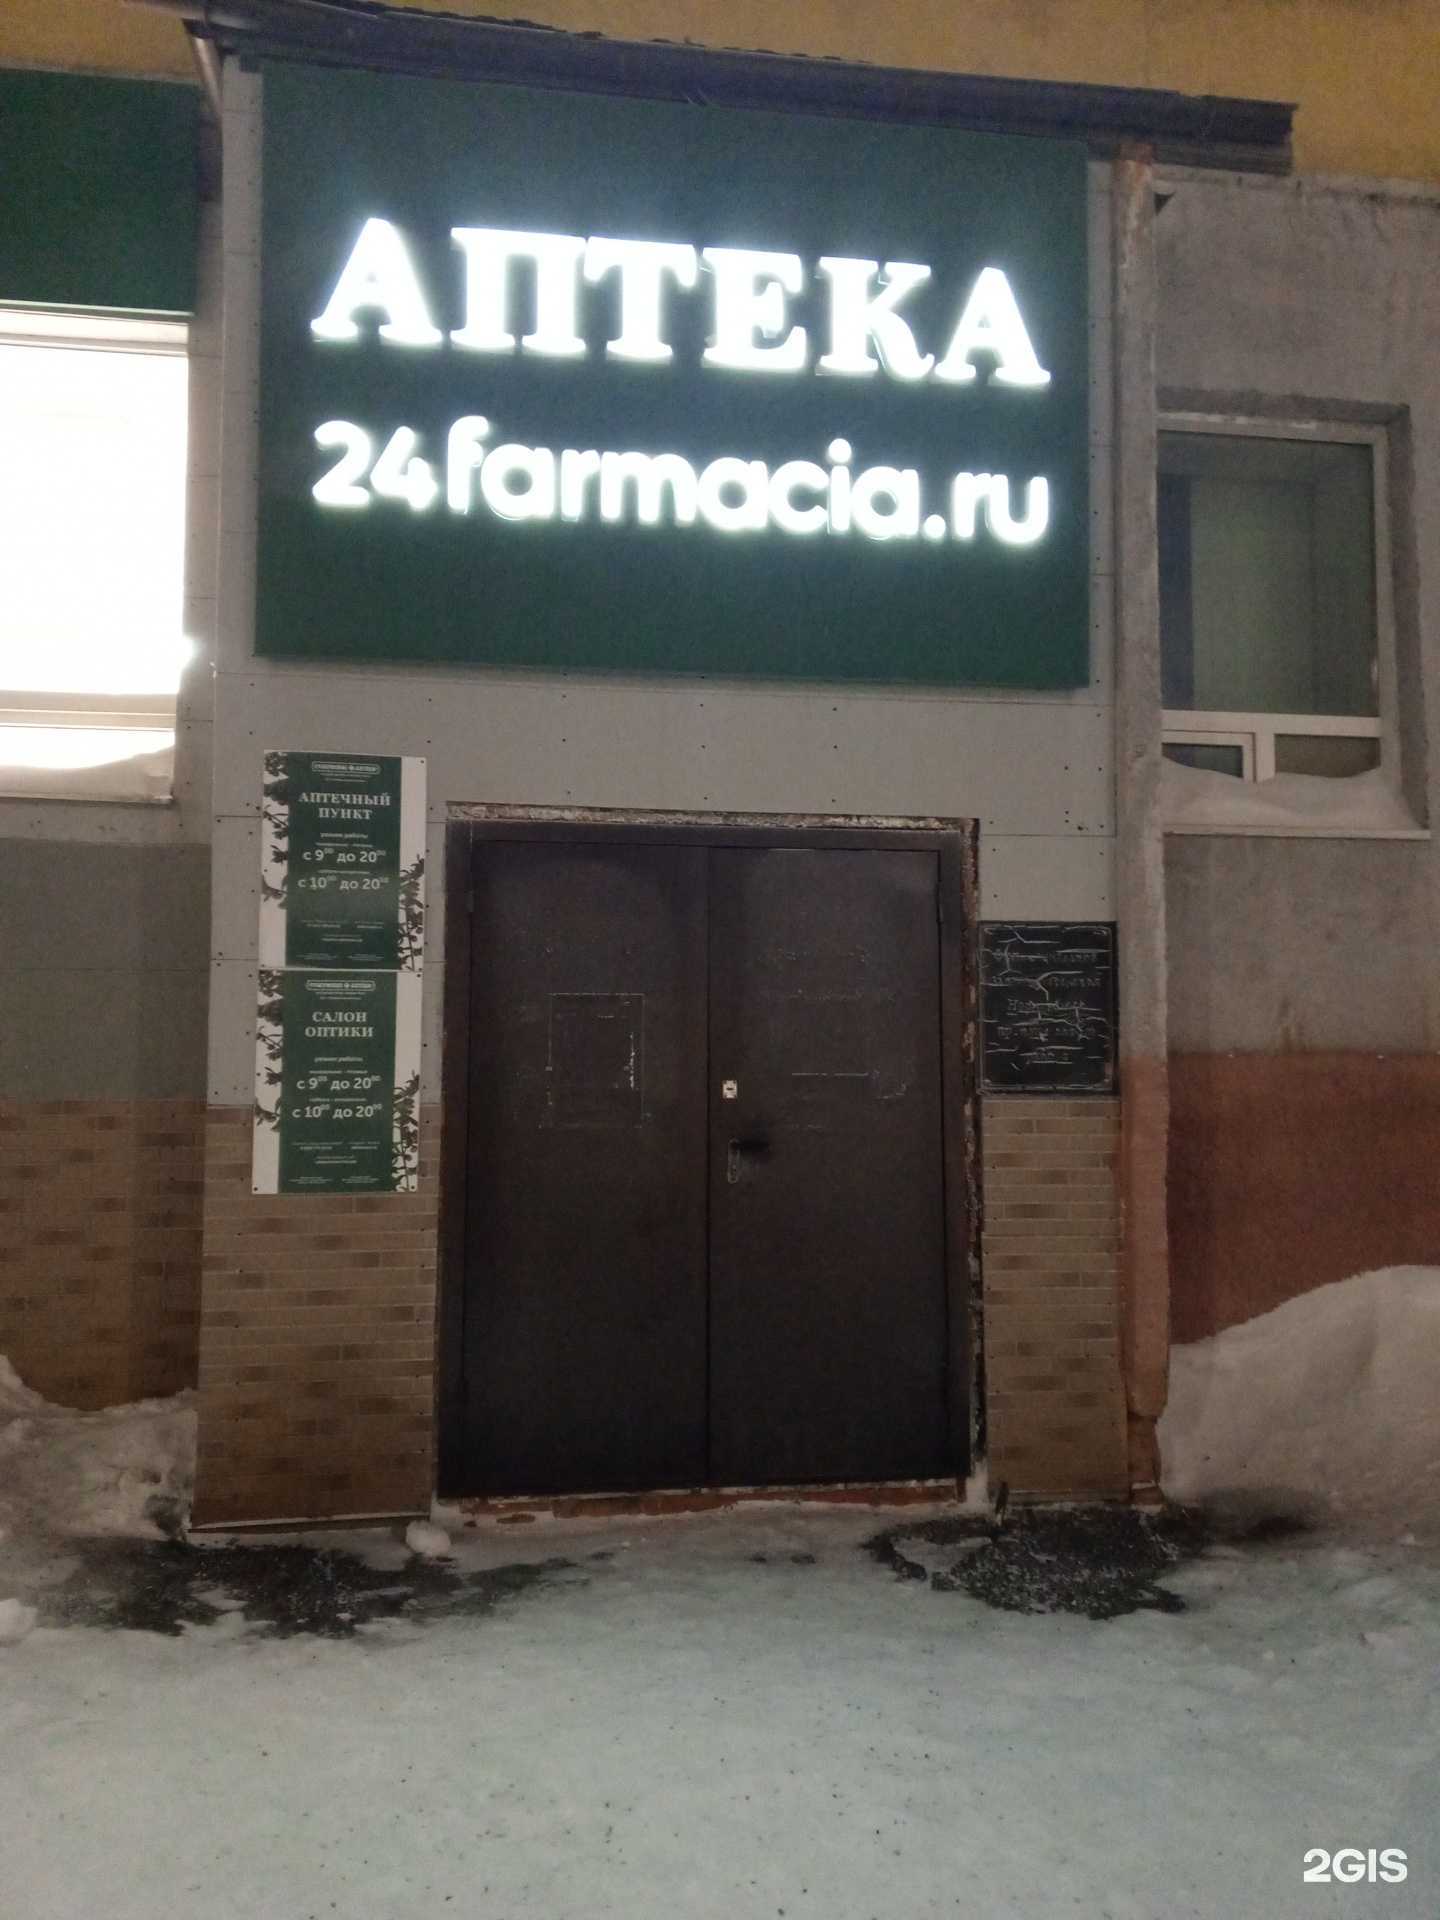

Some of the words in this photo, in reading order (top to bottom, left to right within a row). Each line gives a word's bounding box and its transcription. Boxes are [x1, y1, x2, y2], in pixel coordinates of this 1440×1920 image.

[310, 217, 1052, 386] АПТЕКА
[310, 414, 1051, 544] 24farmacia.ru
[298, 791, 391, 807] АПТЕЧНЫЙ
[318, 806, 373, 820] ПУНКТ
[336, 852, 356, 864] до
[339, 880, 359, 890] до
[312, 1011, 367, 1024] САЛОН
[304, 1026, 374, 1038] ОПТИКИ
[330, 1080, 350, 1090] до
[332, 1108, 352, 1119] до
